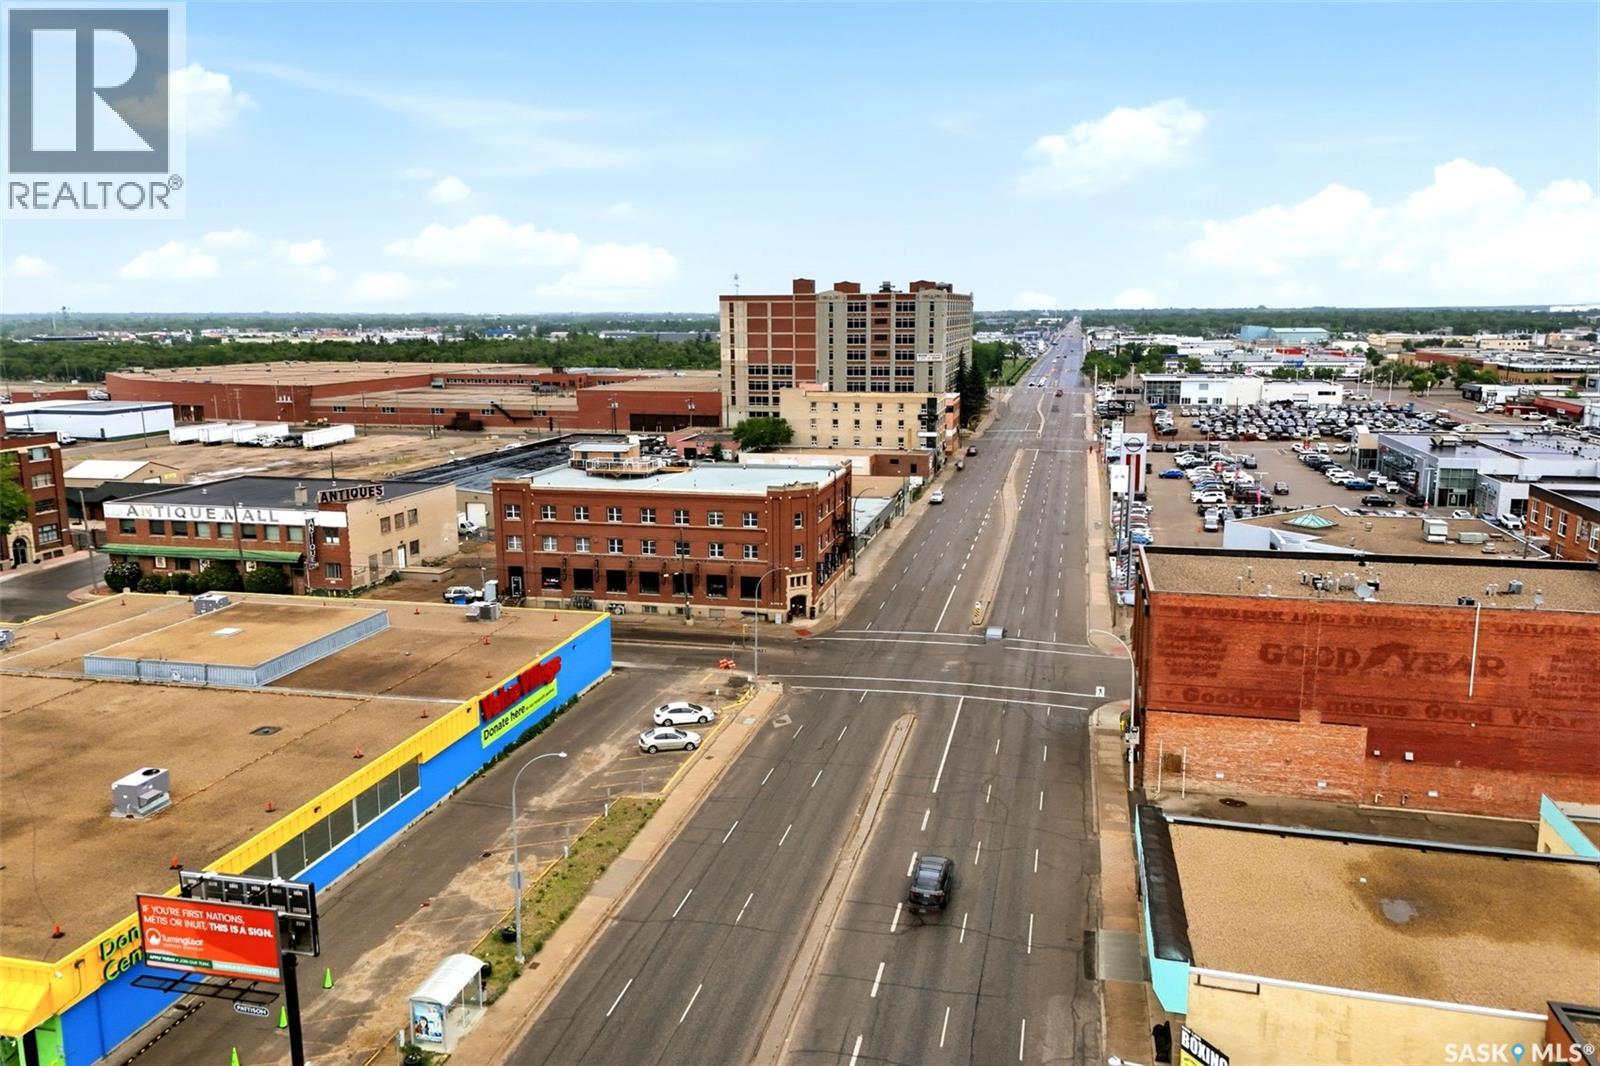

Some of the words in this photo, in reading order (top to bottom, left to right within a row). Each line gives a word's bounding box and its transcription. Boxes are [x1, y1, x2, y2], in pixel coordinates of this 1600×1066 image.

[319, 485, 384, 502] ANTIQUES
[483, 716, 510, 740] Donate
[510, 705, 526, 721] here
[1424, 704, 1493, 723] Good
[142, 905, 150, 913] IF
[151, 905, 181, 917] YOU'RE
[182, 909, 204, 919] FIRST
[205, 911, 245, 925] NATIONS,
[169, 919, 183, 927] OR
[208, 922, 229, 933] THIS
[230, 924, 239, 934] IS
[239, 926, 247, 935] A
[247, 927, 274, 939] SIGN.
[236, 1004, 268, 1016] PATTISON
